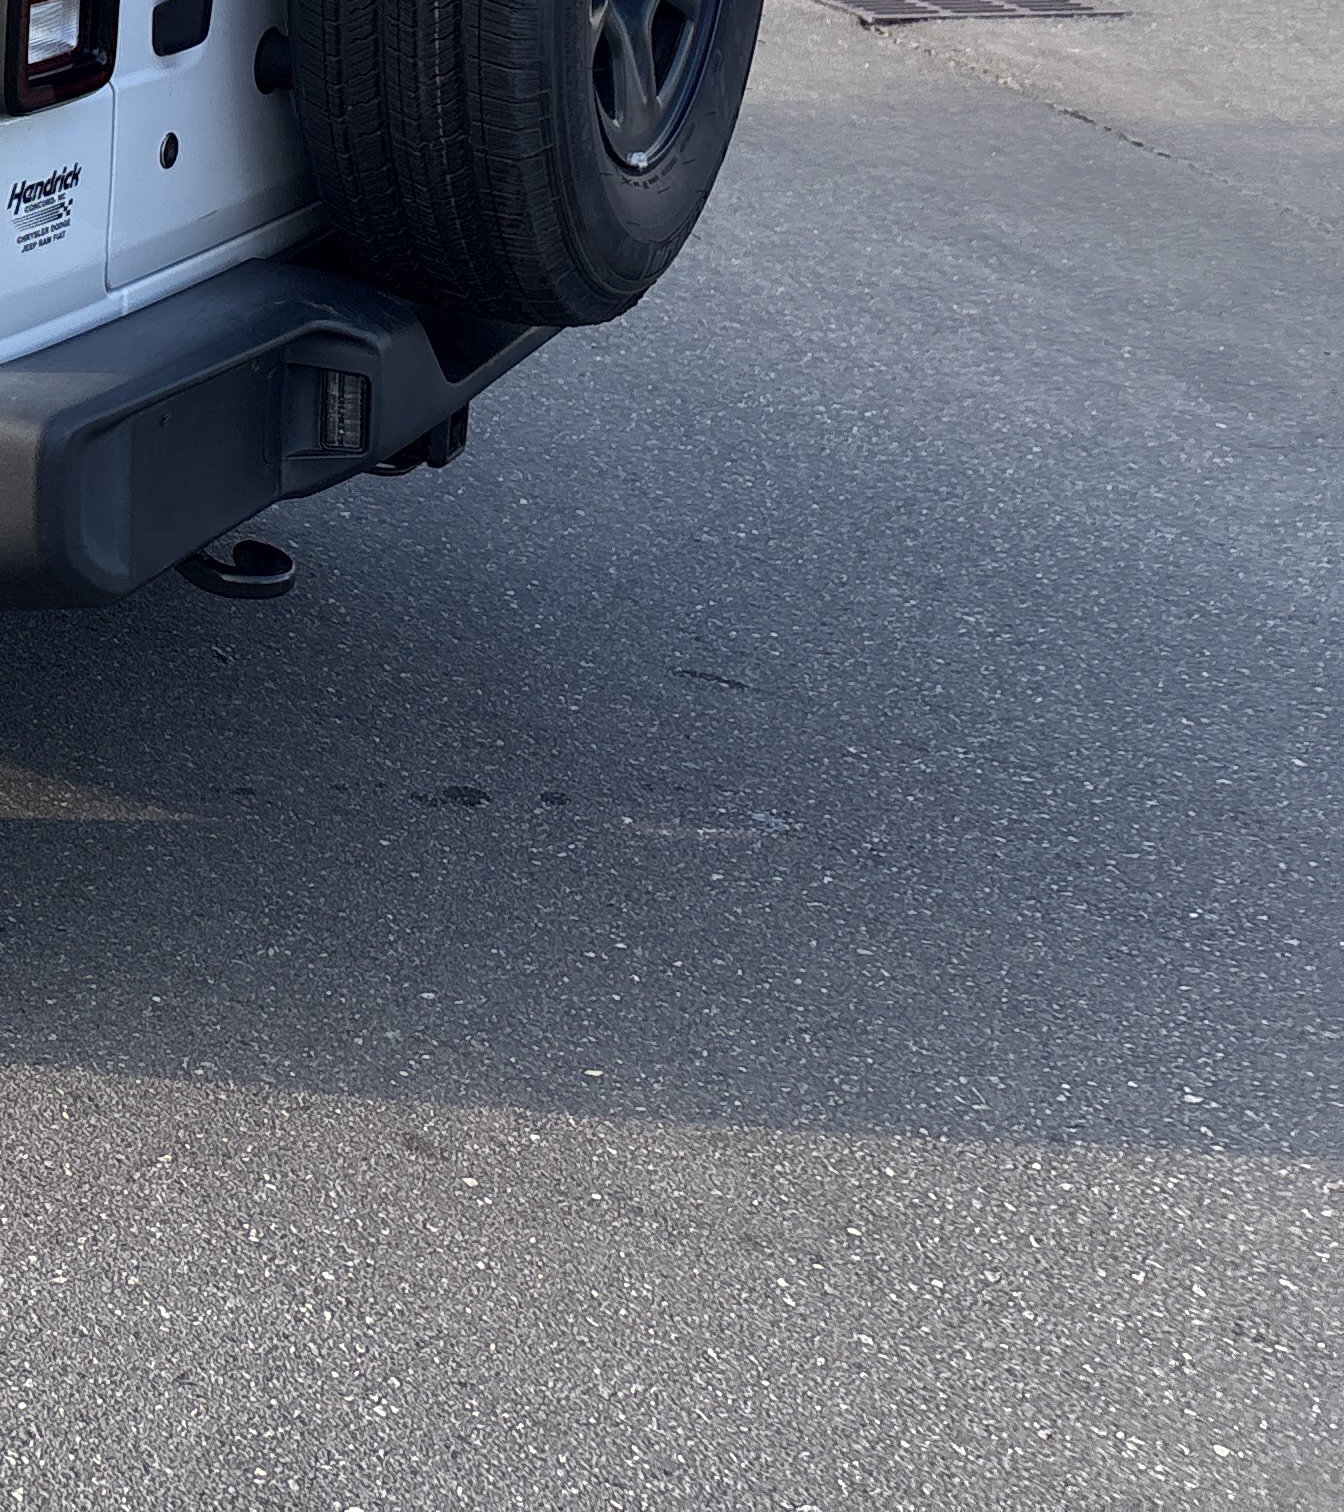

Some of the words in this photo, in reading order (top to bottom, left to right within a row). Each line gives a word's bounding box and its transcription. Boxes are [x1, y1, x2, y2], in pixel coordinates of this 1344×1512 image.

[7, 162, 82, 215] Hendrick
[16, 227, 50, 244] CHRYSLER
[51, 218, 71, 232] DODGE
[21, 242, 37, 253] JEEP
[38, 236, 52, 247] RAM
